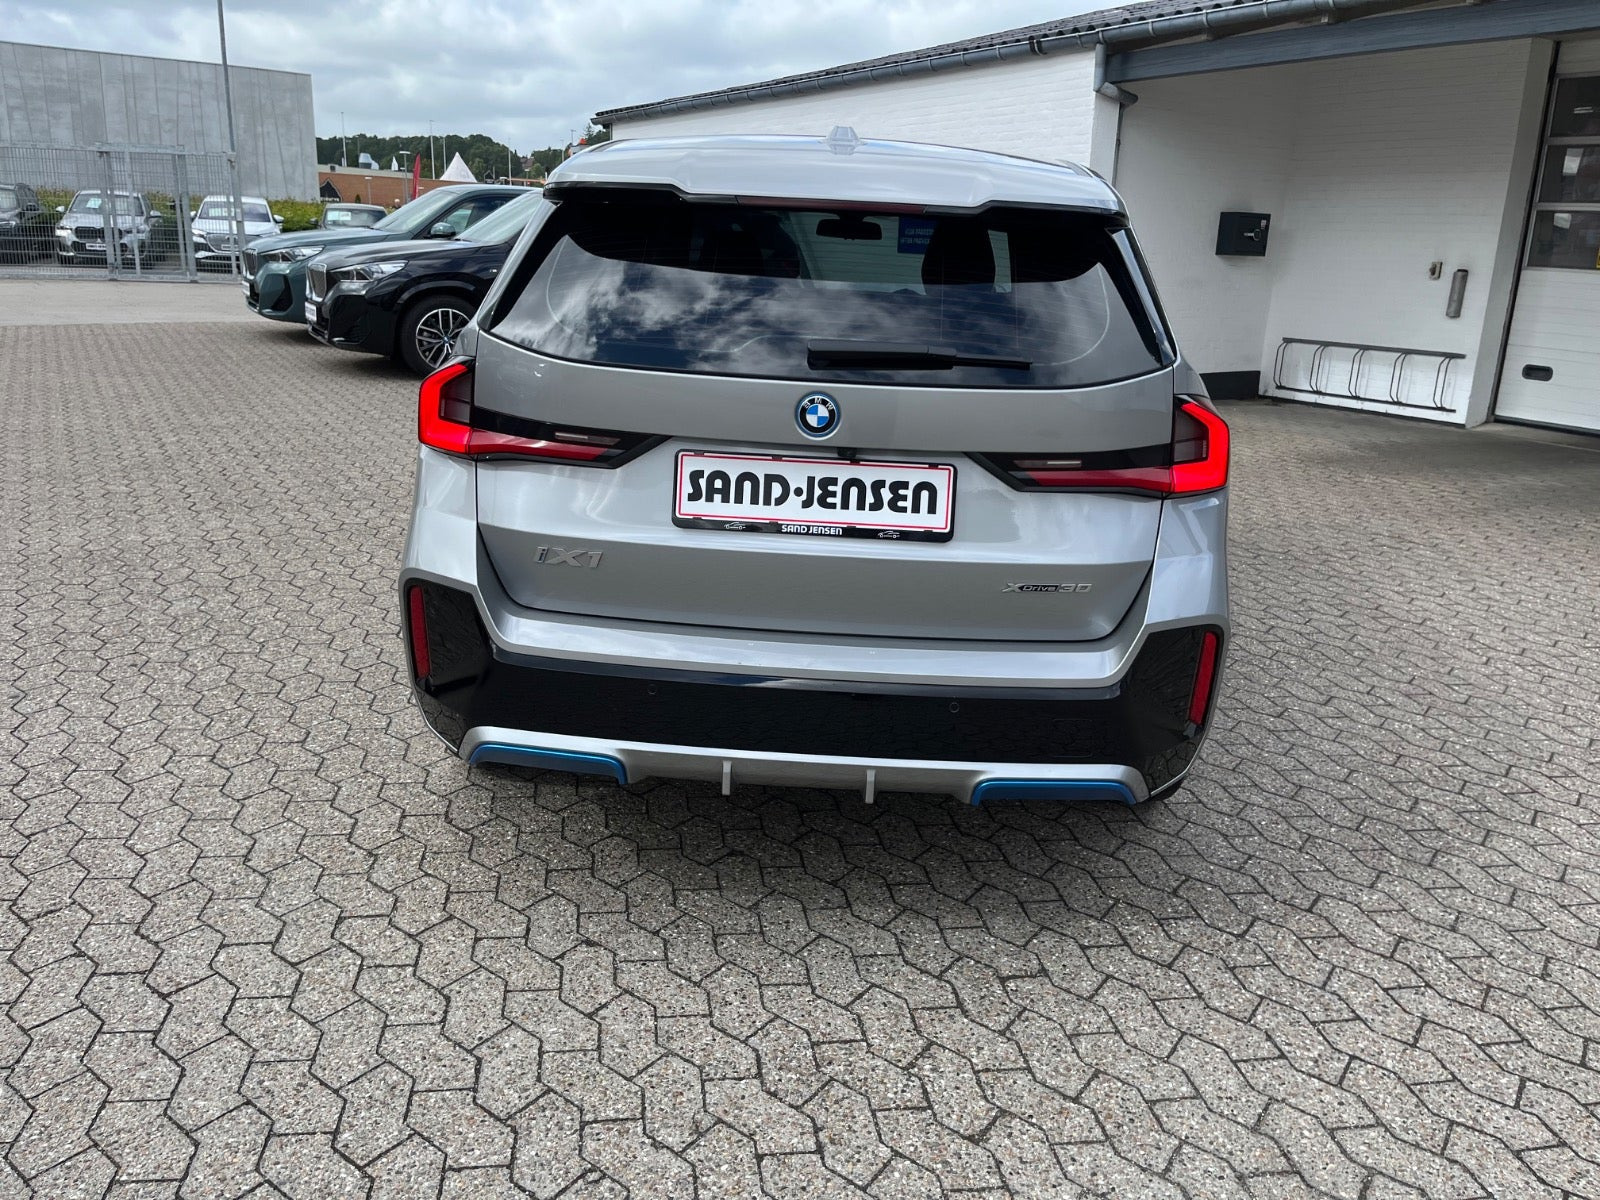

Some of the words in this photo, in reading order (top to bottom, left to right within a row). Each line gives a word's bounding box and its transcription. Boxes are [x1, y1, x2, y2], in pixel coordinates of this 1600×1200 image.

[802, 396, 834, 410] BMW
[781, 524, 807, 534] SAND
[808, 525, 843, 536] JENSEN
[535, 546, 604, 568] iX1
